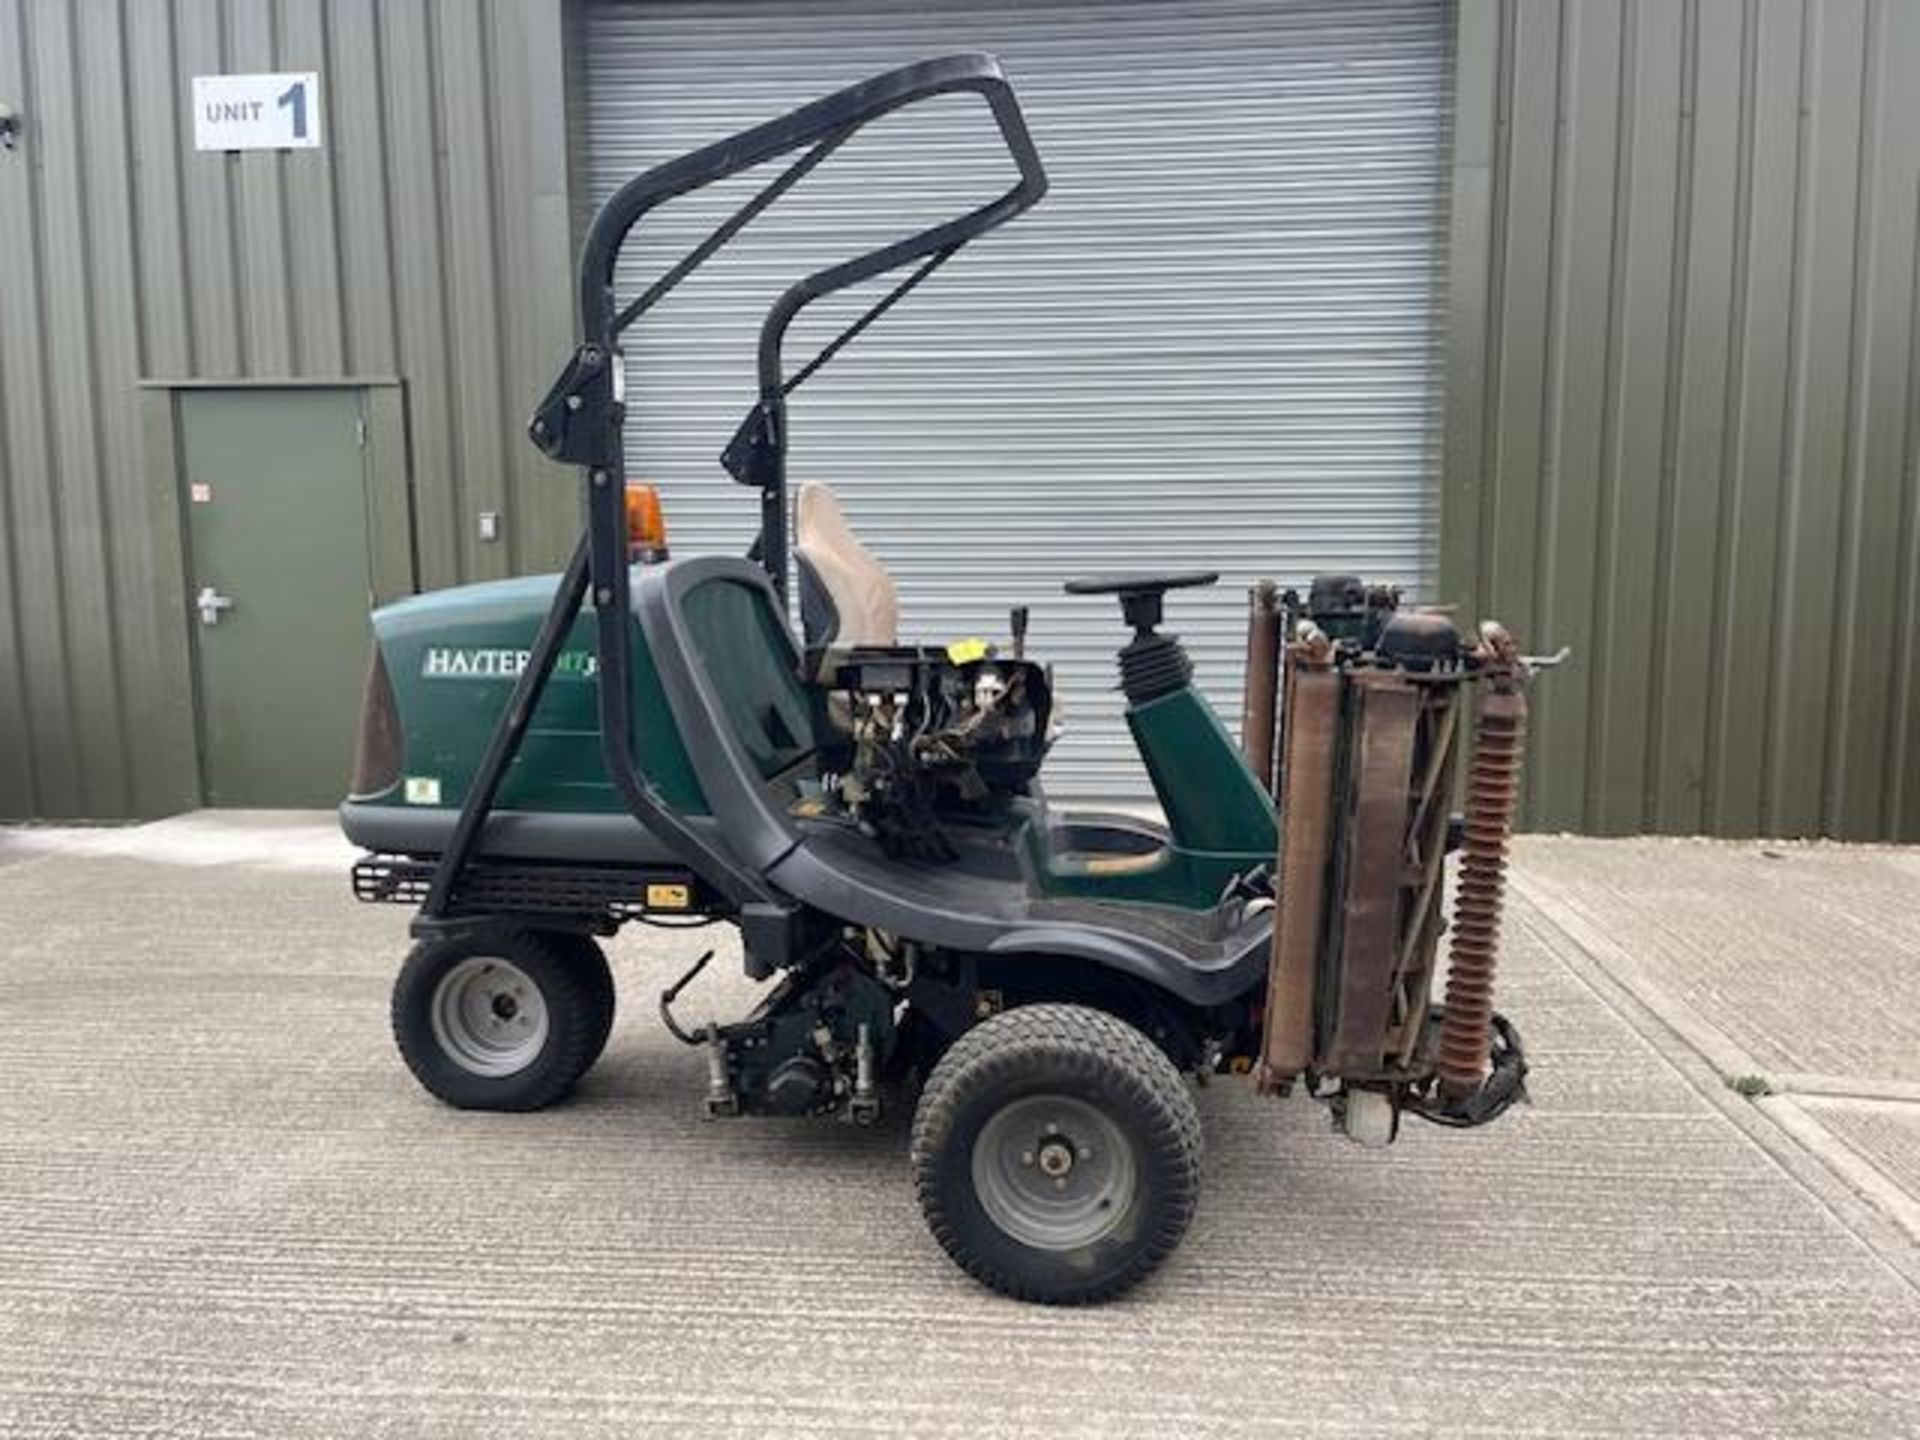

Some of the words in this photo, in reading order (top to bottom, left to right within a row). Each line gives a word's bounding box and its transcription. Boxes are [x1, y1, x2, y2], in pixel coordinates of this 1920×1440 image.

[206, 101, 263, 122] UNIT
[277, 82, 307, 138] 1
[427, 648, 534, 675] HAYTER
